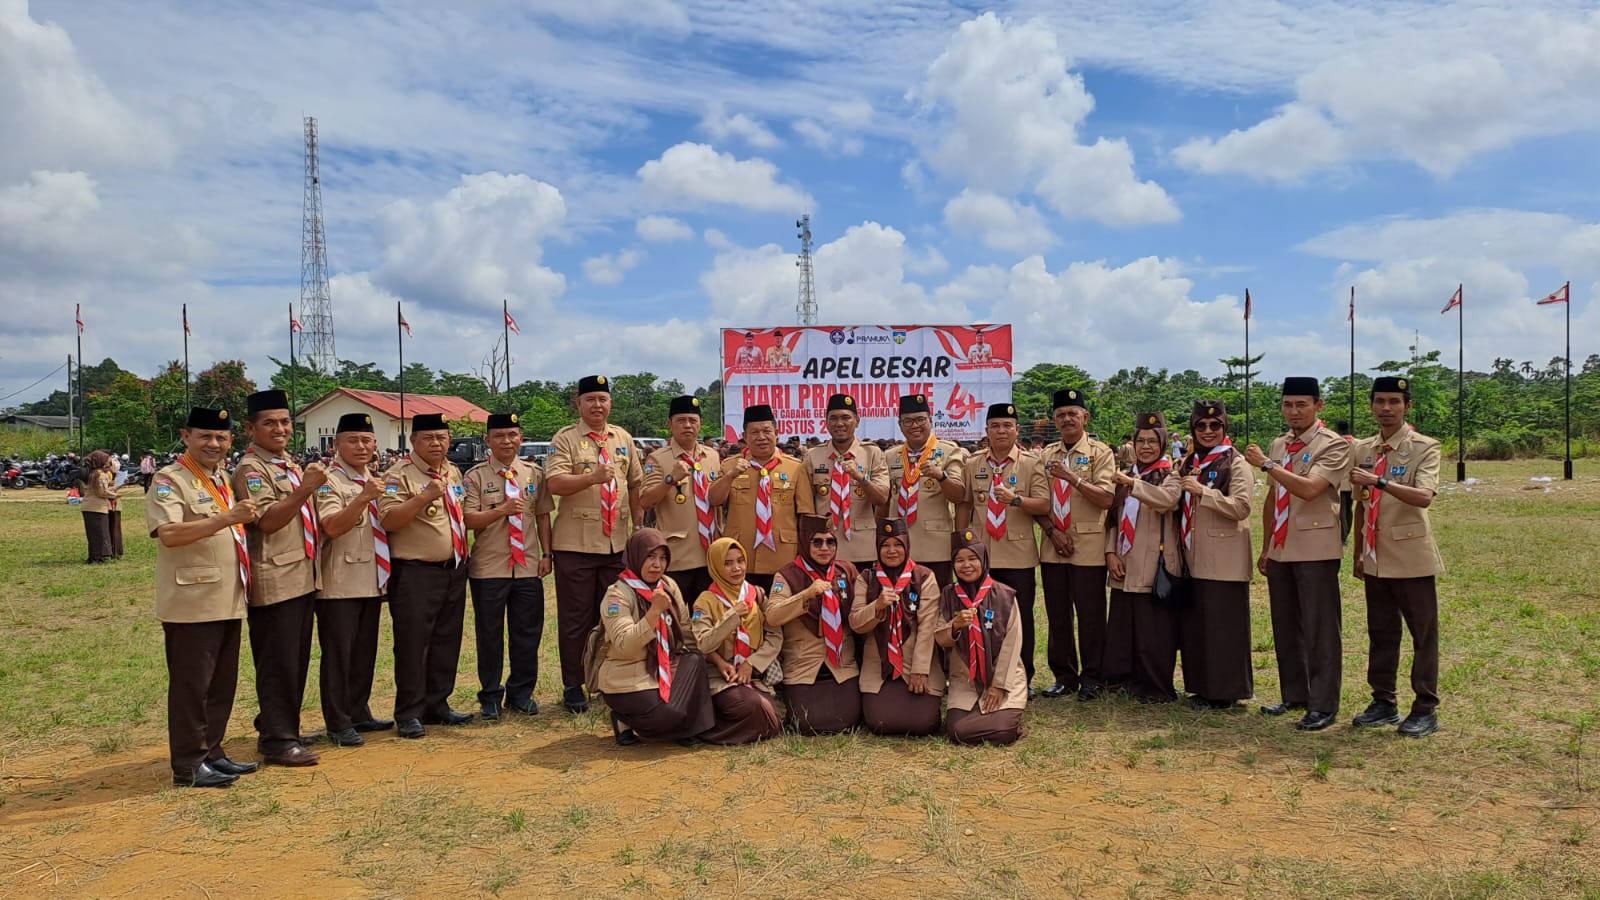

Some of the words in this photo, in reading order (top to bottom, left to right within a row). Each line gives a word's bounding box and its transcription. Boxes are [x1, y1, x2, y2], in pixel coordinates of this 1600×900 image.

[803, 357, 863, 379] APEL
[870, 356, 951, 378] BESAR
[742, 385, 790, 409] HARI
[781, 409, 811, 418] CABANG
[857, 408, 890, 417] RAMUKA
[778, 420, 814, 434] USTUS
